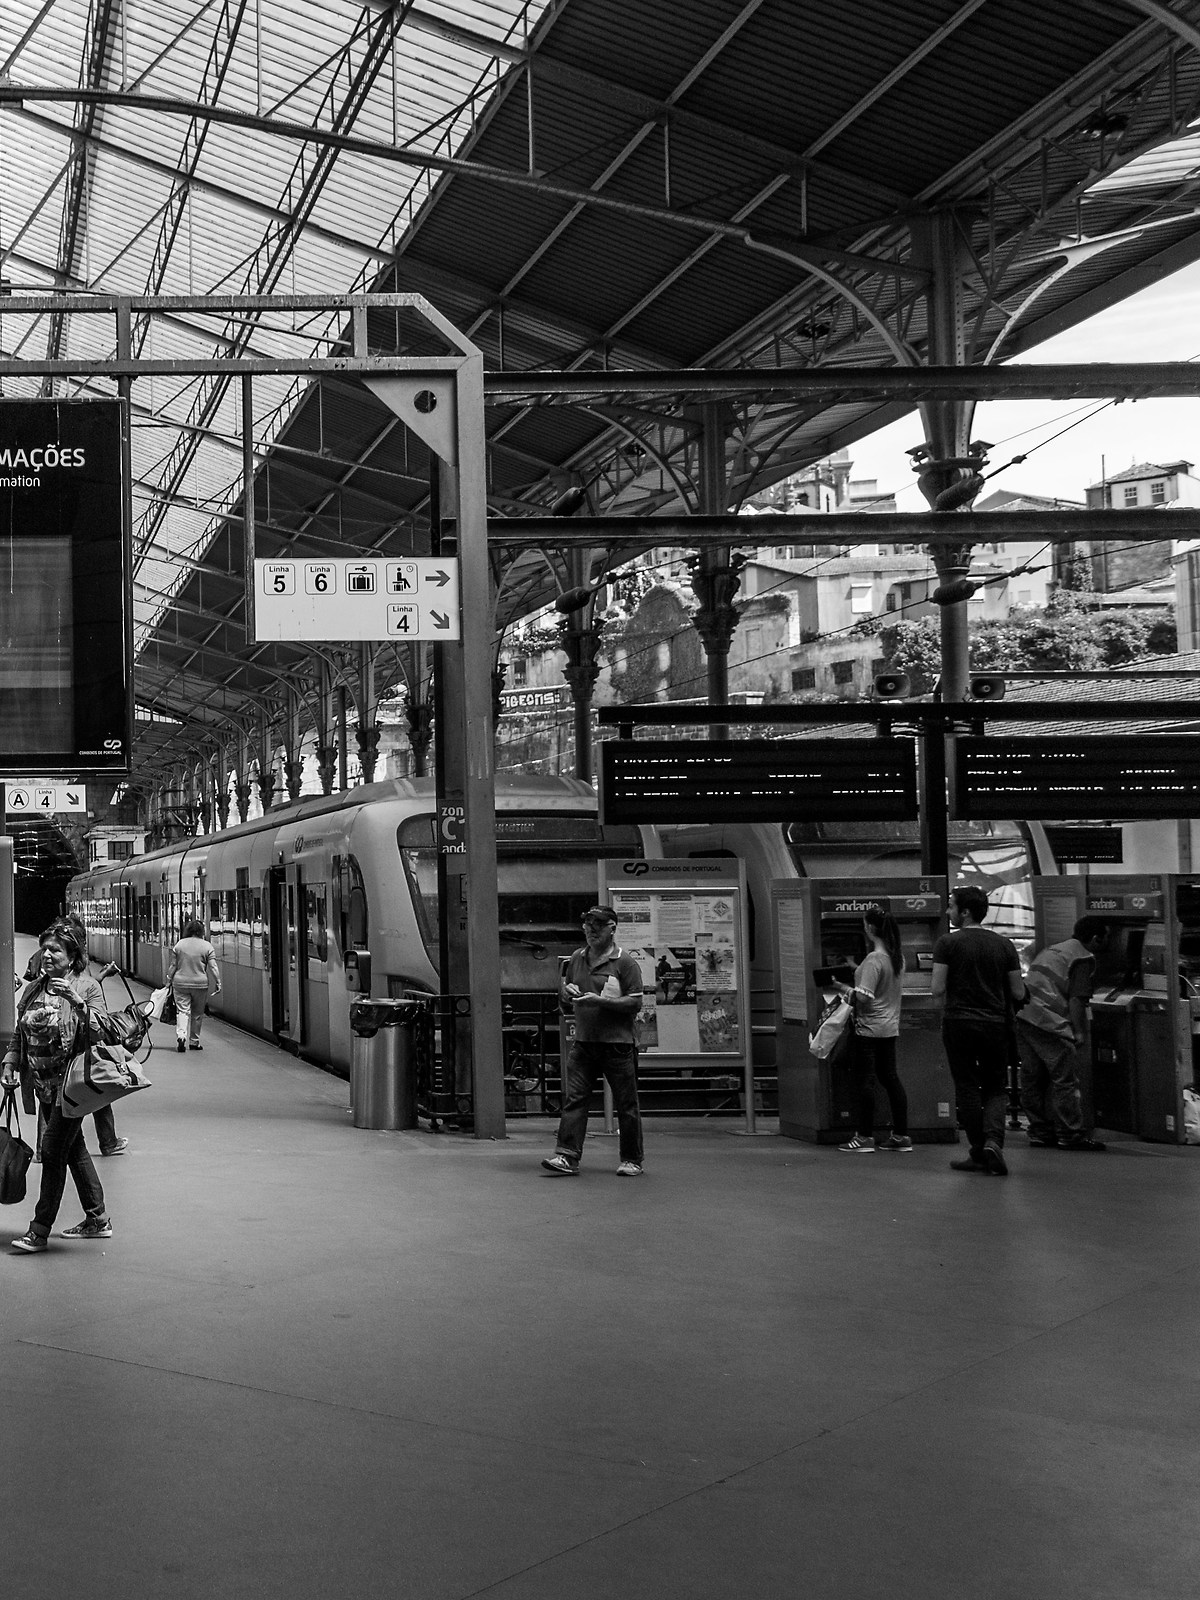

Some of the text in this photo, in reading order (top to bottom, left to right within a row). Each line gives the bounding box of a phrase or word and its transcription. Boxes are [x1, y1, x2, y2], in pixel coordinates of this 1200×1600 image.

[268, 565, 289, 573] Linha
[310, 565, 331, 573] Linha
[273, 575, 286, 593] 5
[315, 573, 328, 592] 6
[396, 615, 410, 633] 4
[13, 793, 25, 806] A
[40, 796, 50, 808] 4
[441, 807, 464, 817] zon
[441, 817, 466, 840] C
